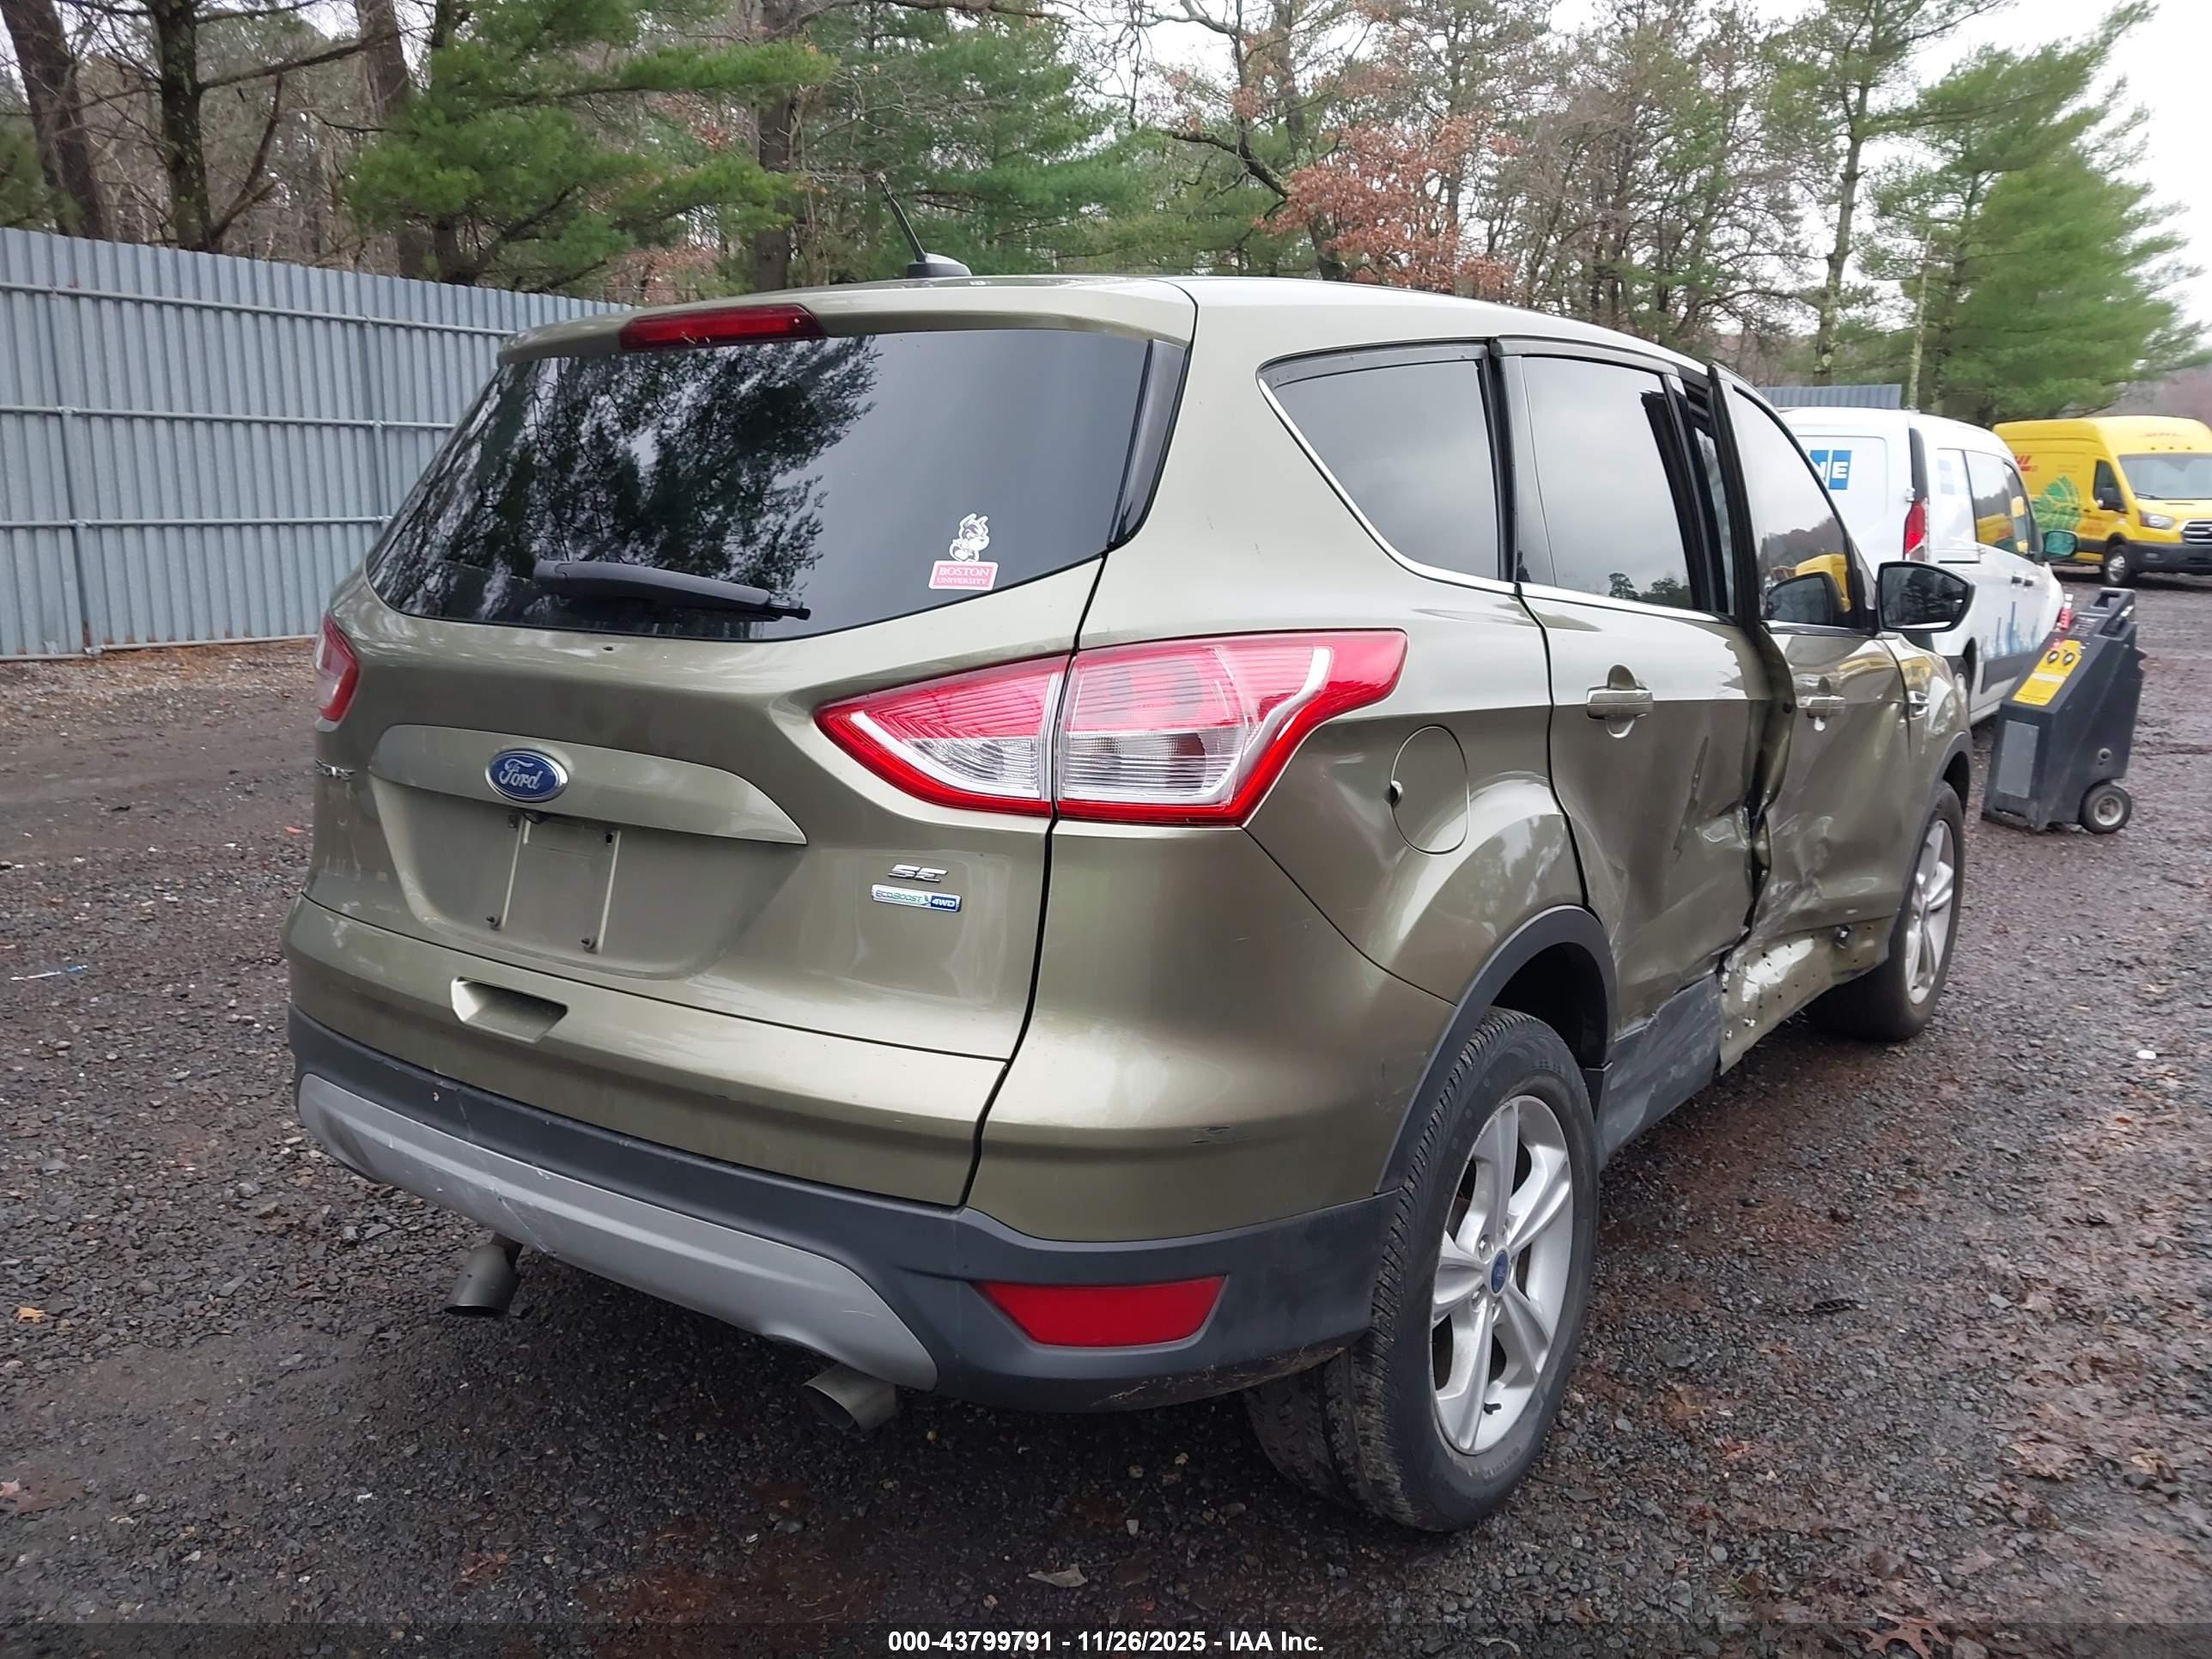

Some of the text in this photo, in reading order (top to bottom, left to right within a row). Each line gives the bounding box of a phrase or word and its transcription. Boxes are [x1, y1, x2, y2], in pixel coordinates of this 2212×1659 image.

[939, 567, 989, 576] BOSTON
[936, 576, 986, 585] UNIVERSITY
[498, 758, 544, 790] Ford
[887, 864, 949, 883] SE
[931, 898, 956, 908] 4WD
